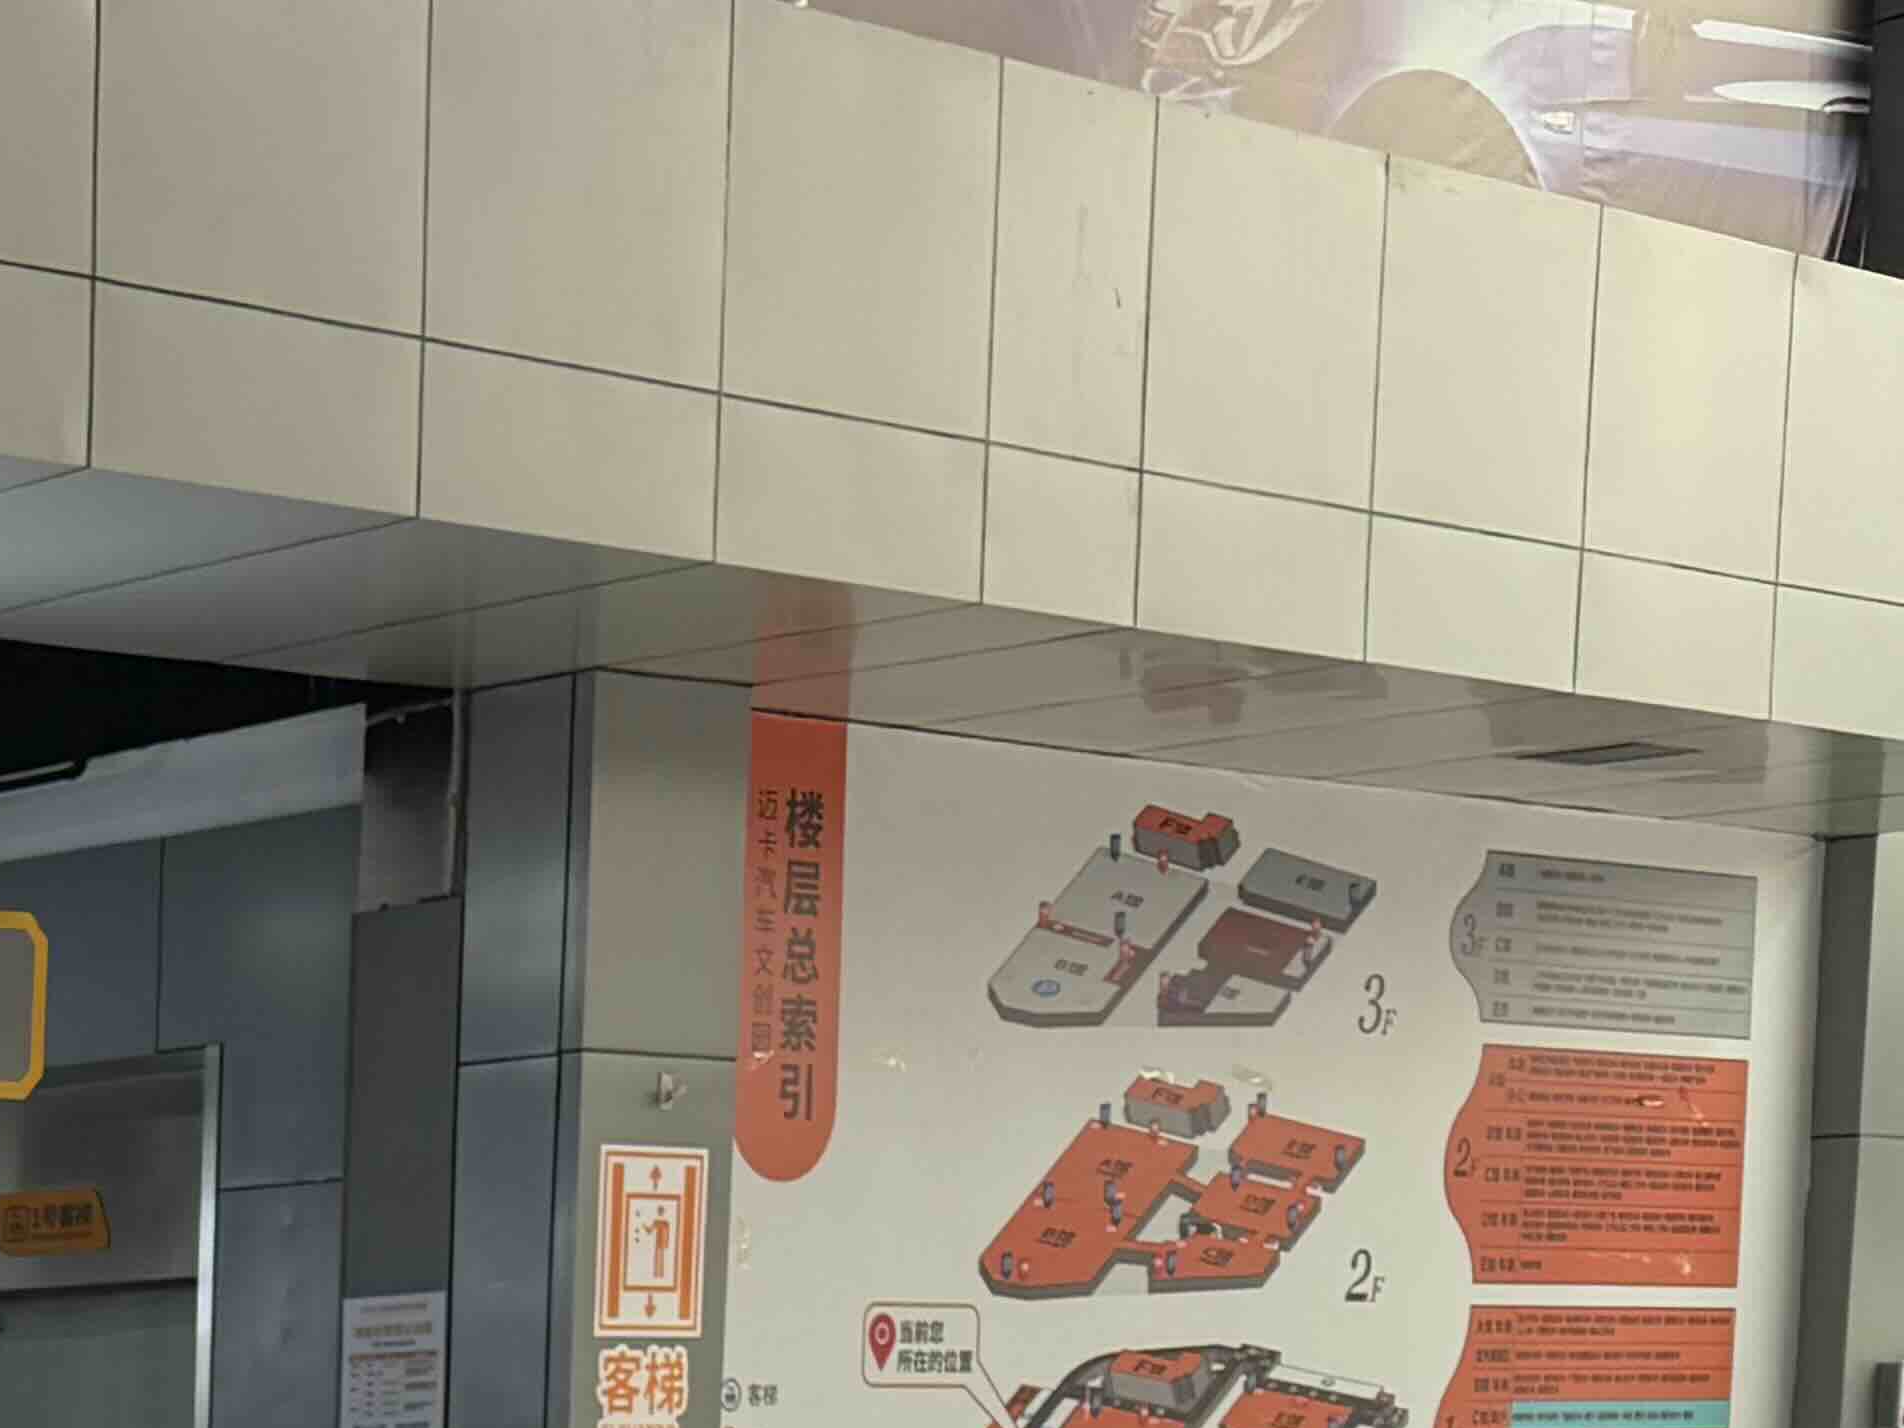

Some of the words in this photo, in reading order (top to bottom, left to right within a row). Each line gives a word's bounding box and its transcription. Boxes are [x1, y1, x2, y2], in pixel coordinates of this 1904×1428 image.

[778, 788, 825, 1122] 楼层总索引
[1357, 973, 1398, 1036] 3F
[1344, 1249, 1386, 1302] 2F
[603, 1351, 684, 1416] 客梯
